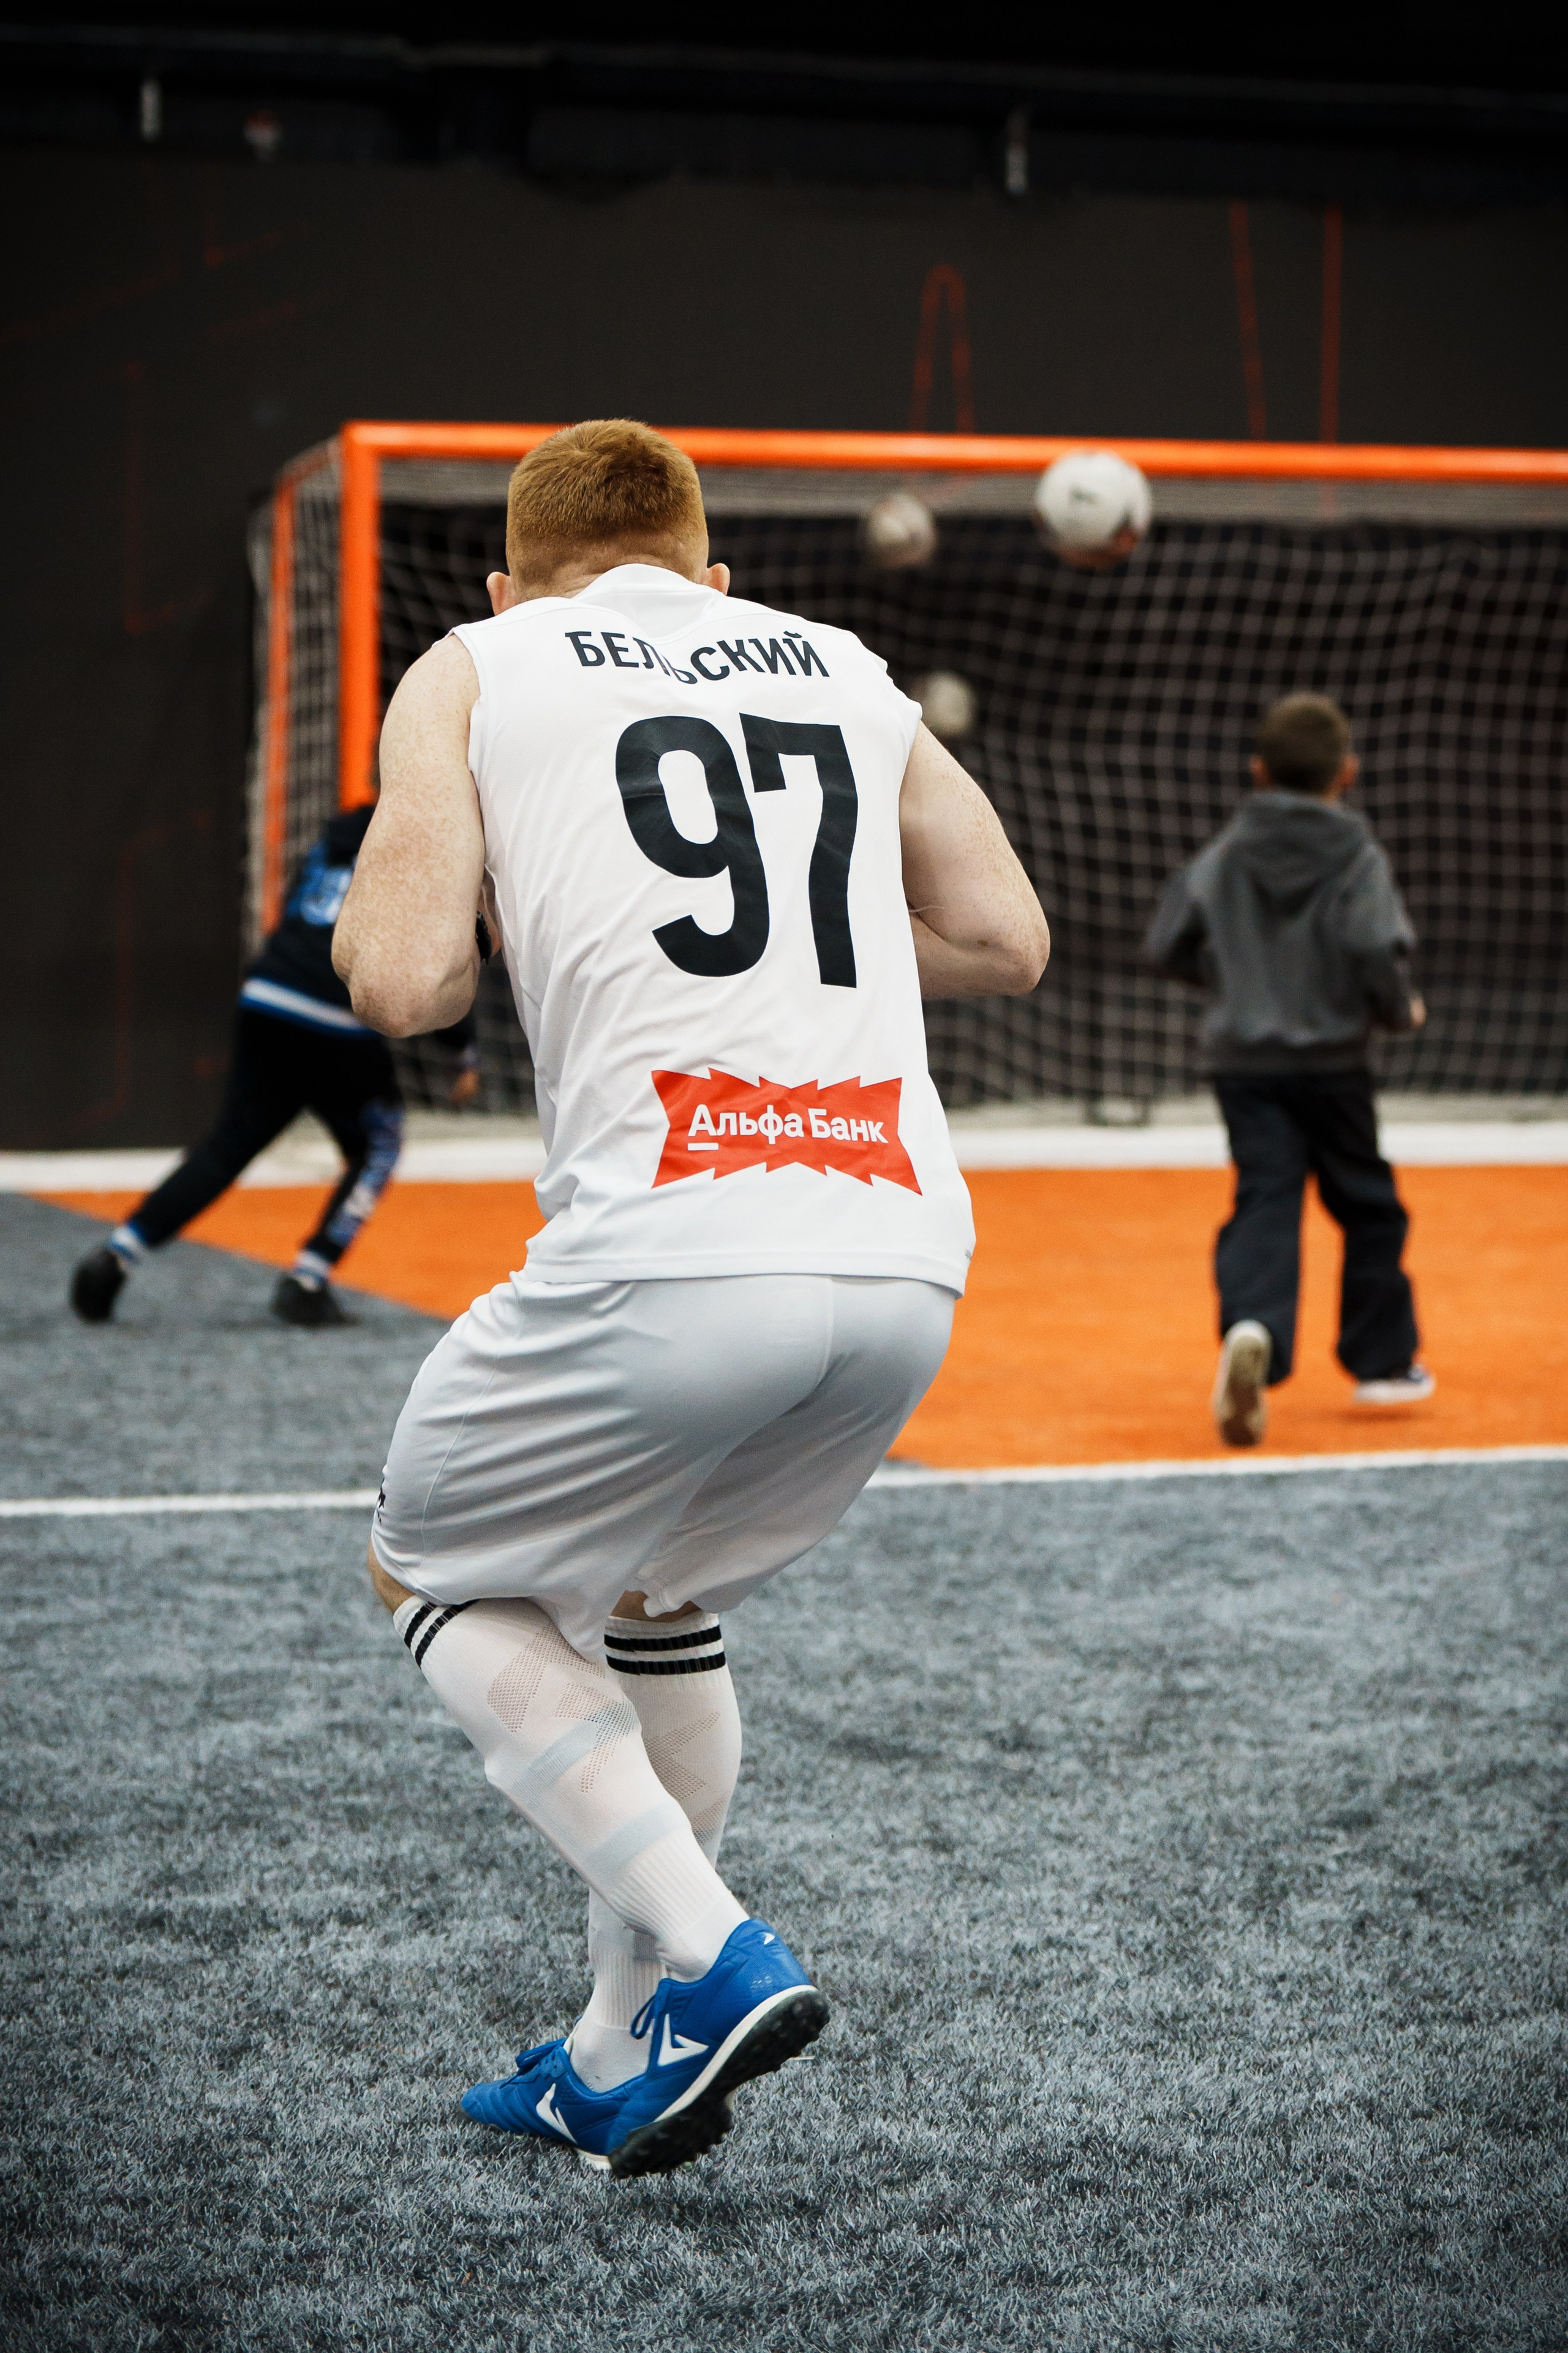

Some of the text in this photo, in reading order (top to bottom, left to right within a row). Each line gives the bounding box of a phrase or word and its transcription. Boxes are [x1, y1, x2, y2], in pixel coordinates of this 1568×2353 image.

[565, 630, 830, 684] БЕЛЬСКИЙ
[616, 712, 859, 988] 97
[687, 1104, 889, 1150] Альфа Банк
